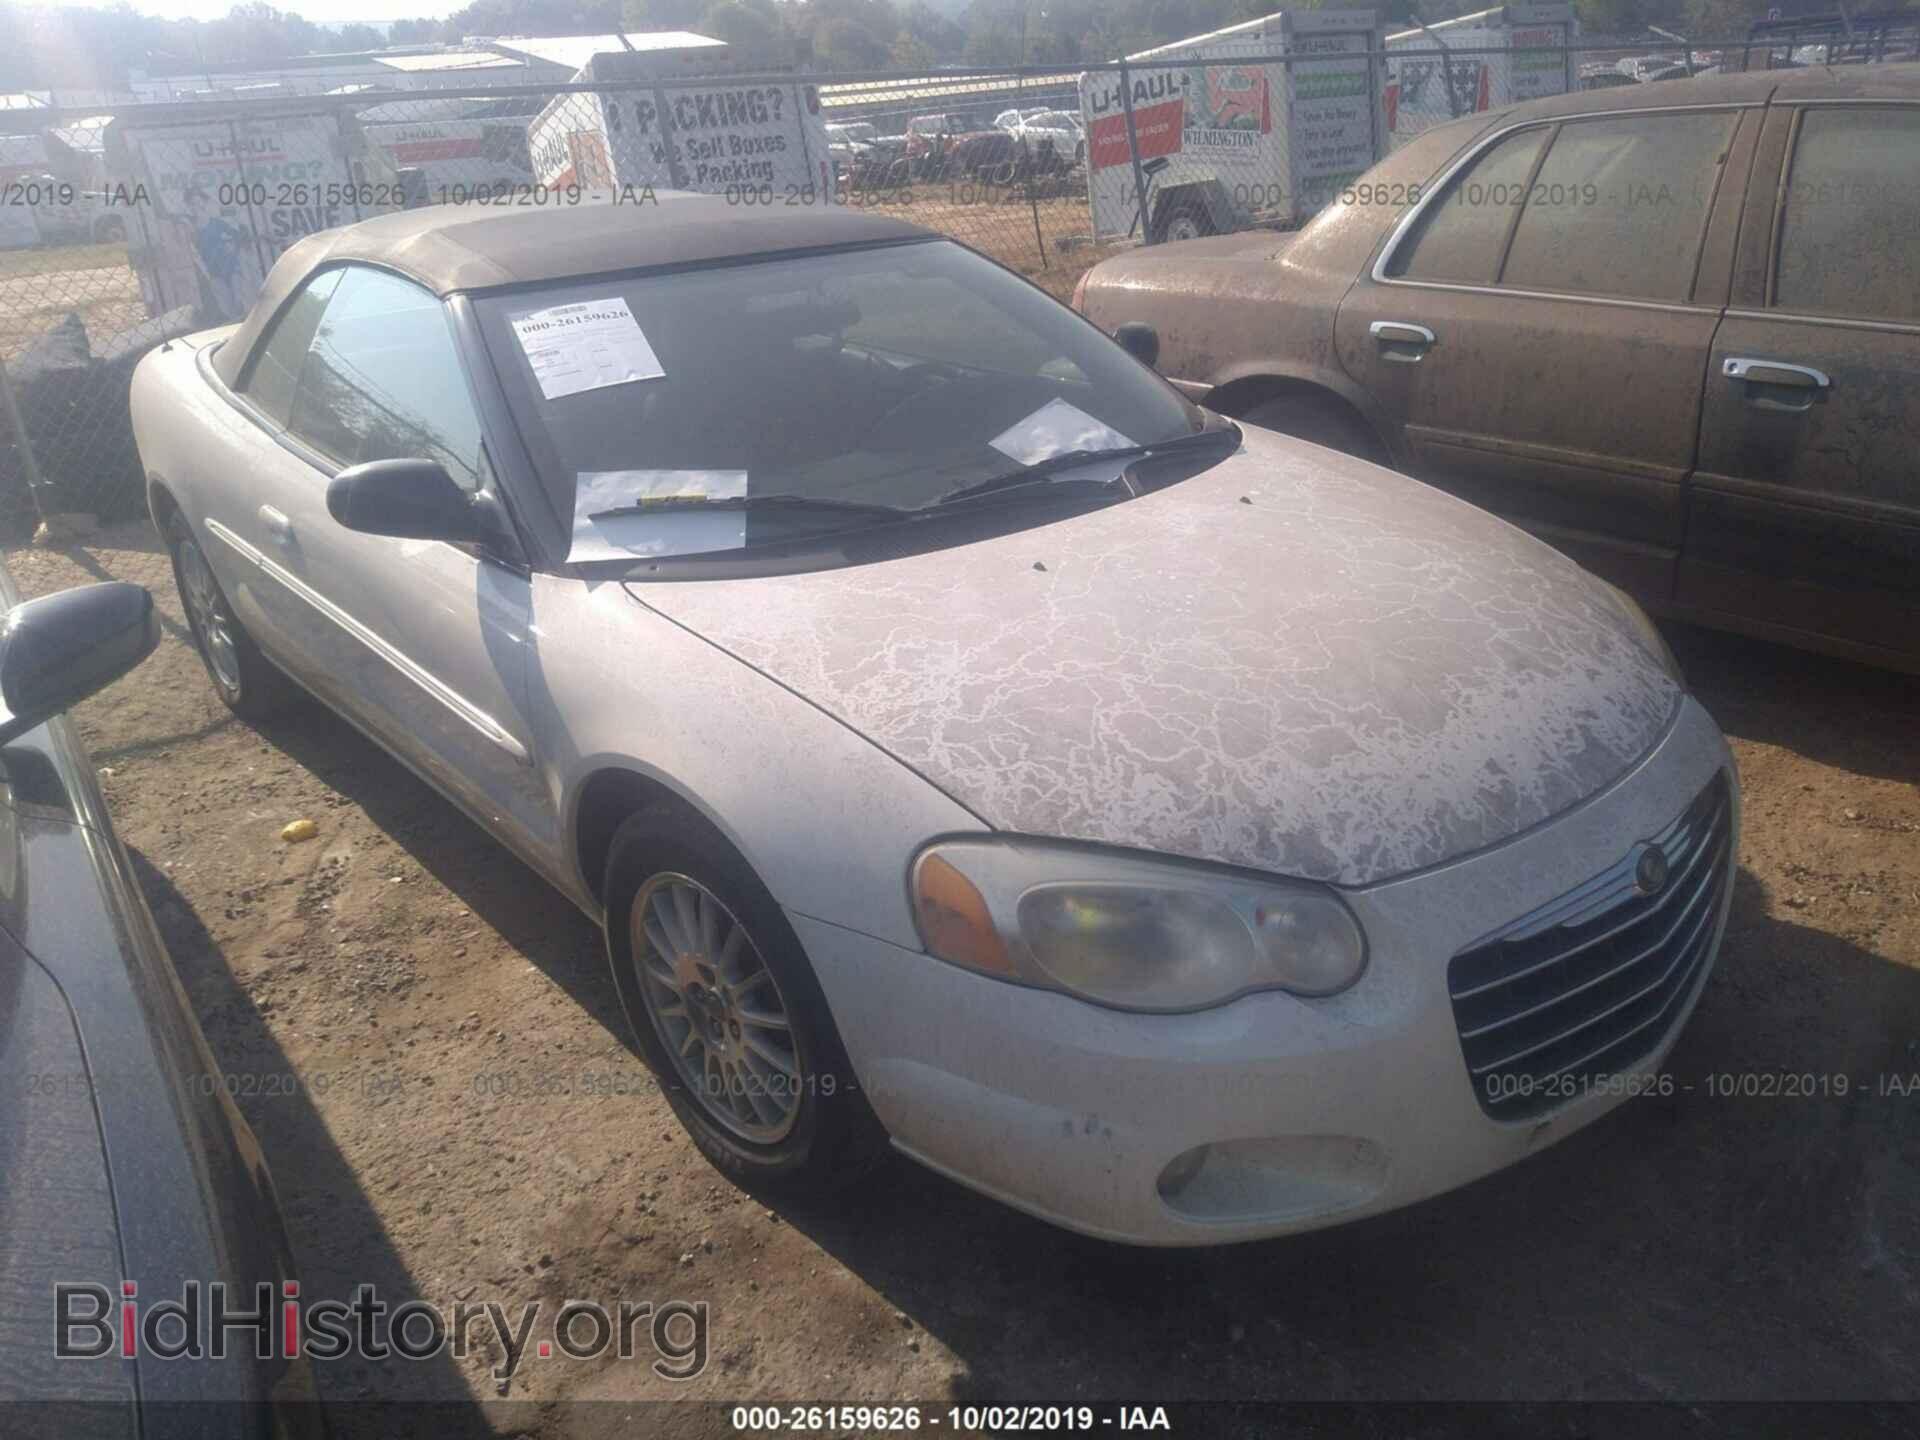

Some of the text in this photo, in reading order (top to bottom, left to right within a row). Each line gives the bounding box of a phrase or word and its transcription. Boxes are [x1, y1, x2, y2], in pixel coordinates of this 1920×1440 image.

[686, 134, 725, 161] Sell
[728, 134, 787, 158] Boxes
[695, 157, 776, 185] Packing
[270, 206, 341, 238] SAVE
[522, 309, 630, 334] 000-26159626
